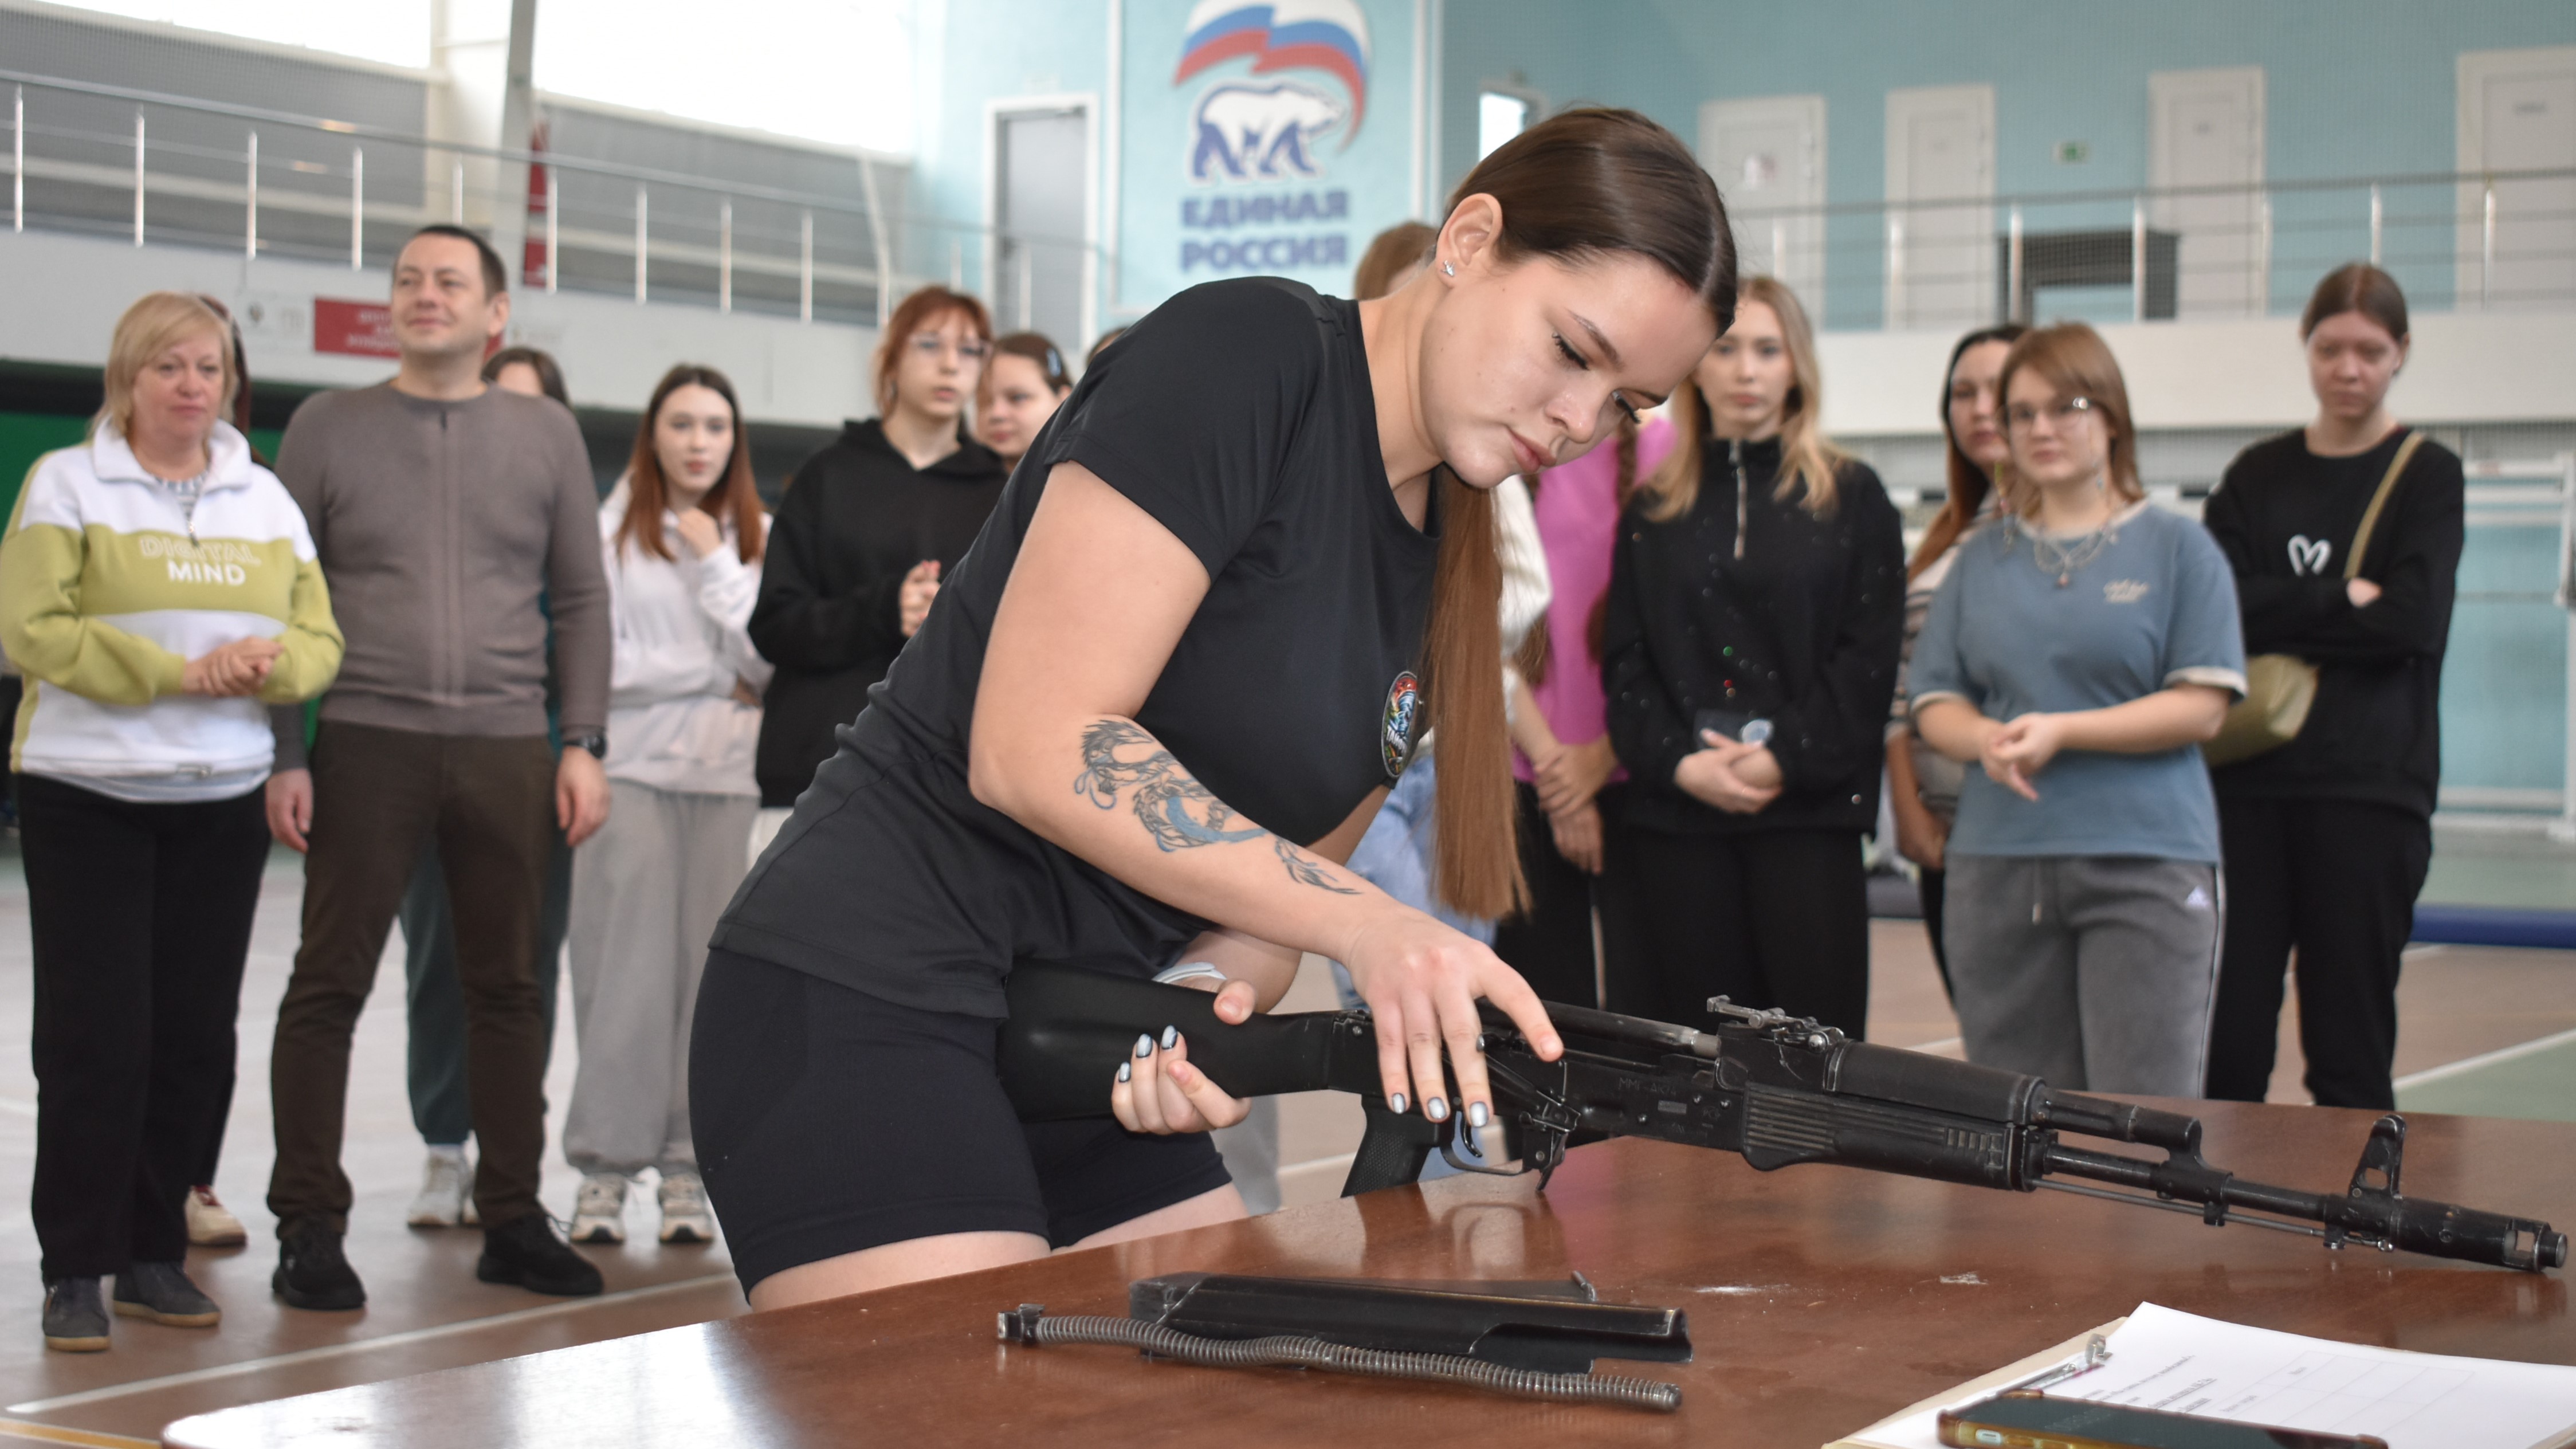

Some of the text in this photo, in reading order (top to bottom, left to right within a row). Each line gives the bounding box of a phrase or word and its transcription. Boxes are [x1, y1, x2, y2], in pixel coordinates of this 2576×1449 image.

[1182, 190, 1348, 227] ЕДИНАЯ
[1181, 235, 1348, 273] РОССИЯ
[140, 535, 261, 565] DIGITAL
[167, 559, 246, 586] MIND
